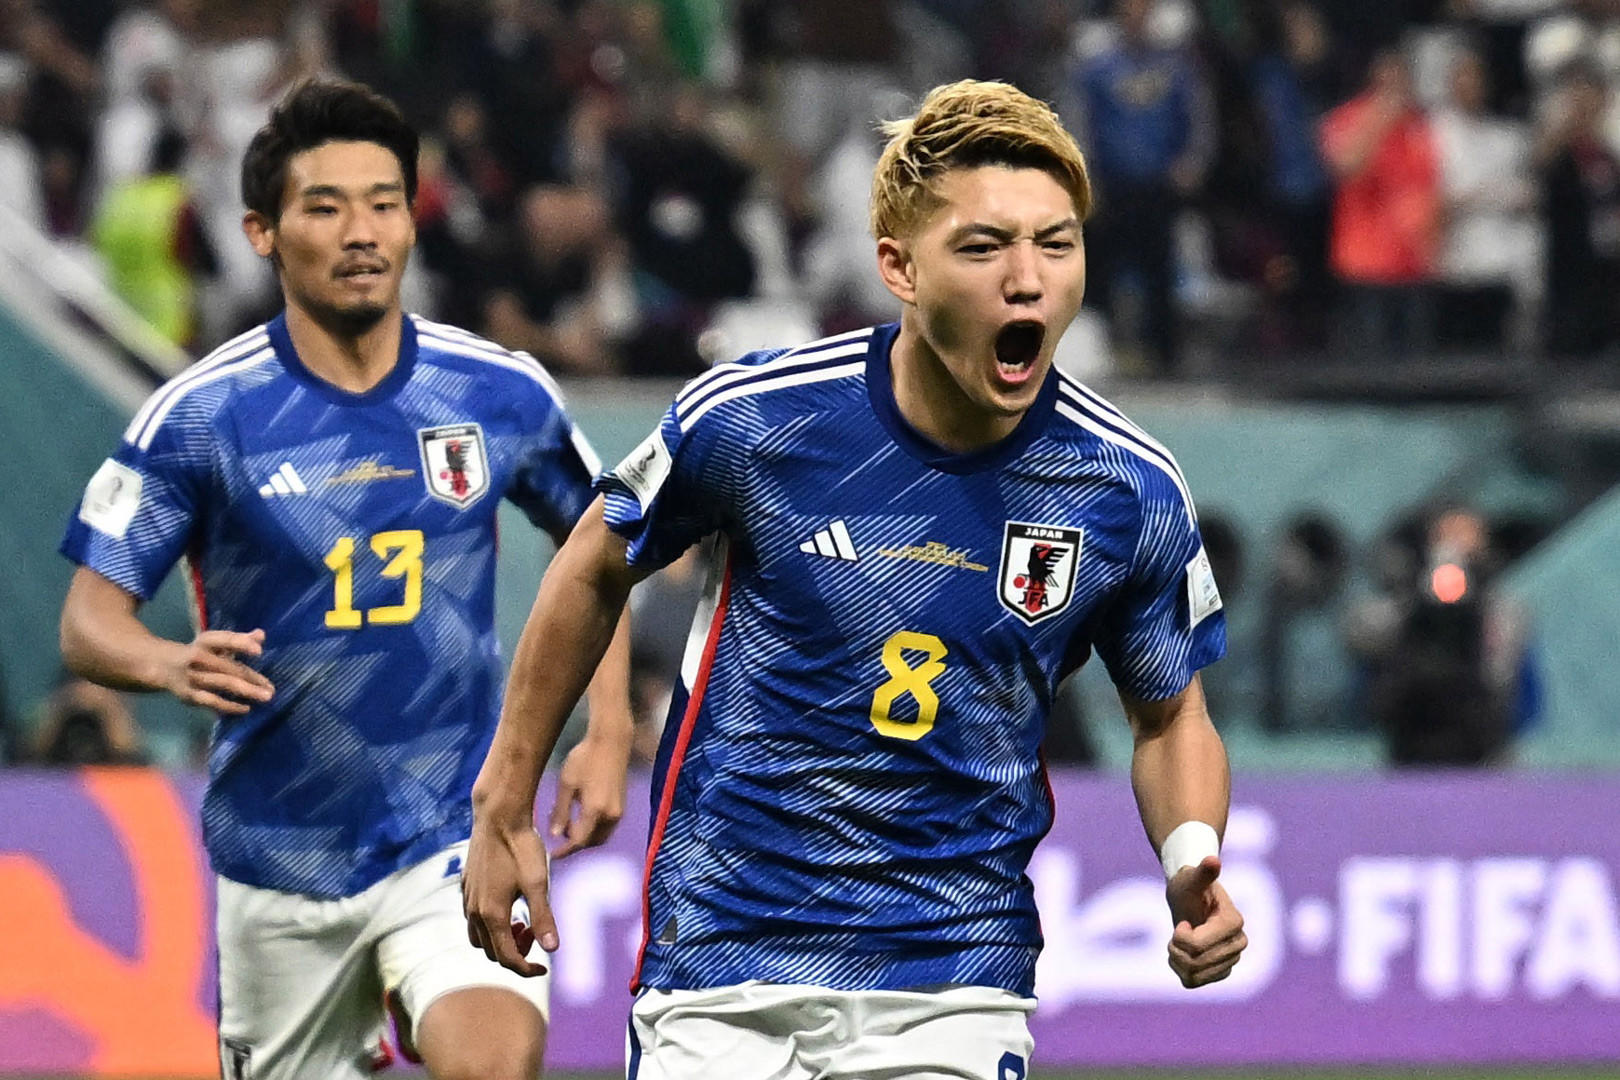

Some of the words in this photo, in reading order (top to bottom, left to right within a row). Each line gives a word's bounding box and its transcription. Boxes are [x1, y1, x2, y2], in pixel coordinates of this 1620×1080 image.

[323, 529, 426, 631] 13
[1024, 527, 1064, 539] JAPAN
[1017, 590, 1050, 608] JFA
[869, 629, 949, 741] 8
[1336, 855, 1620, 1000] FIFA
